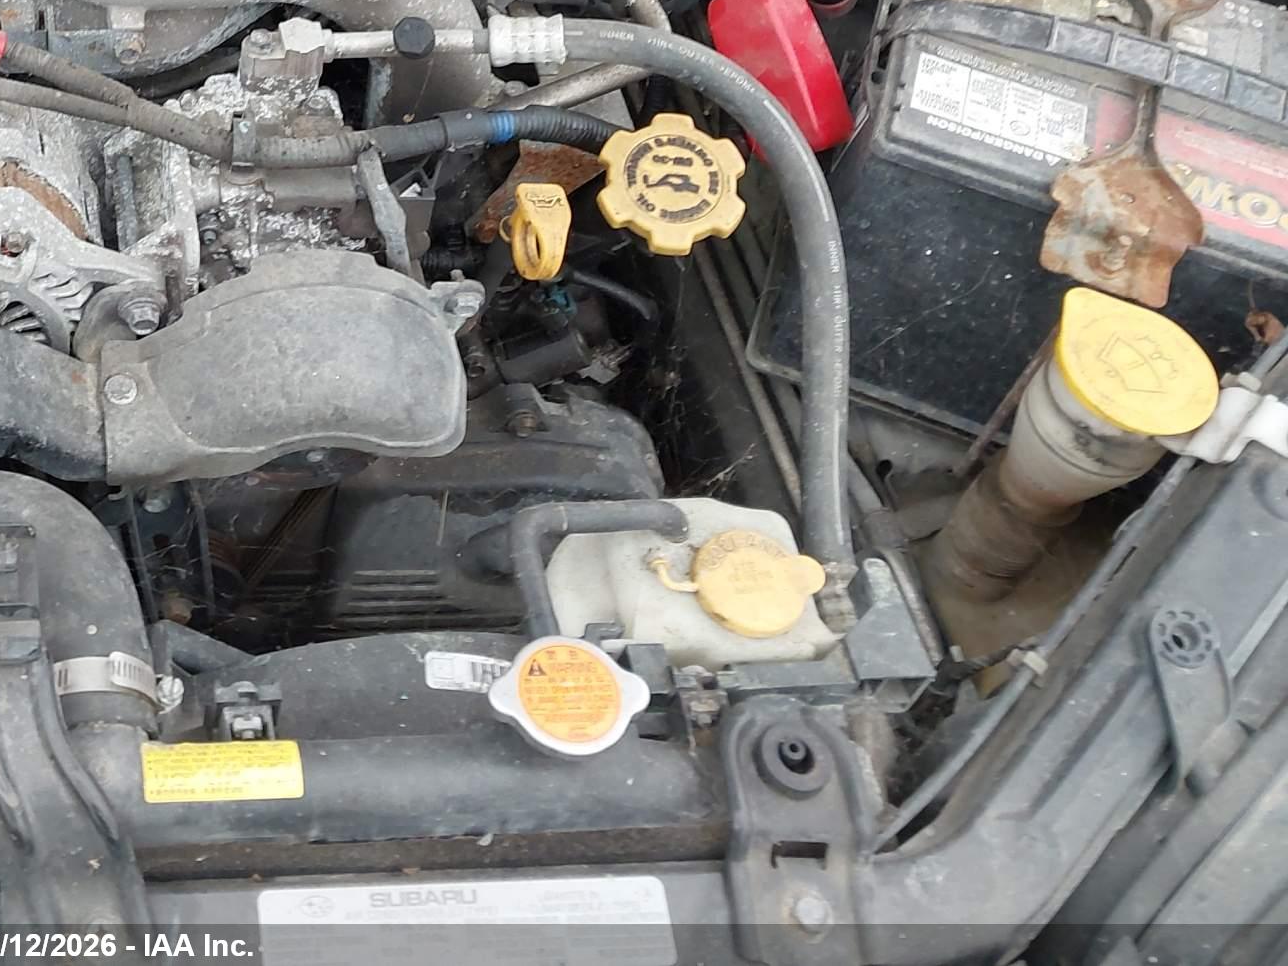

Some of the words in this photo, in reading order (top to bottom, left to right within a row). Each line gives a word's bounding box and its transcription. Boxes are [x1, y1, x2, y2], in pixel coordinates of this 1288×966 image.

[926, 115, 1045, 162] DANGER/POISON
[626, 141, 653, 188] MANUAL
[708, 170, 720, 196] SEE
[636, 193, 657, 213] OIL
[659, 198, 712, 220] ENGINE
[368, 888, 478, 909] SUBARU
